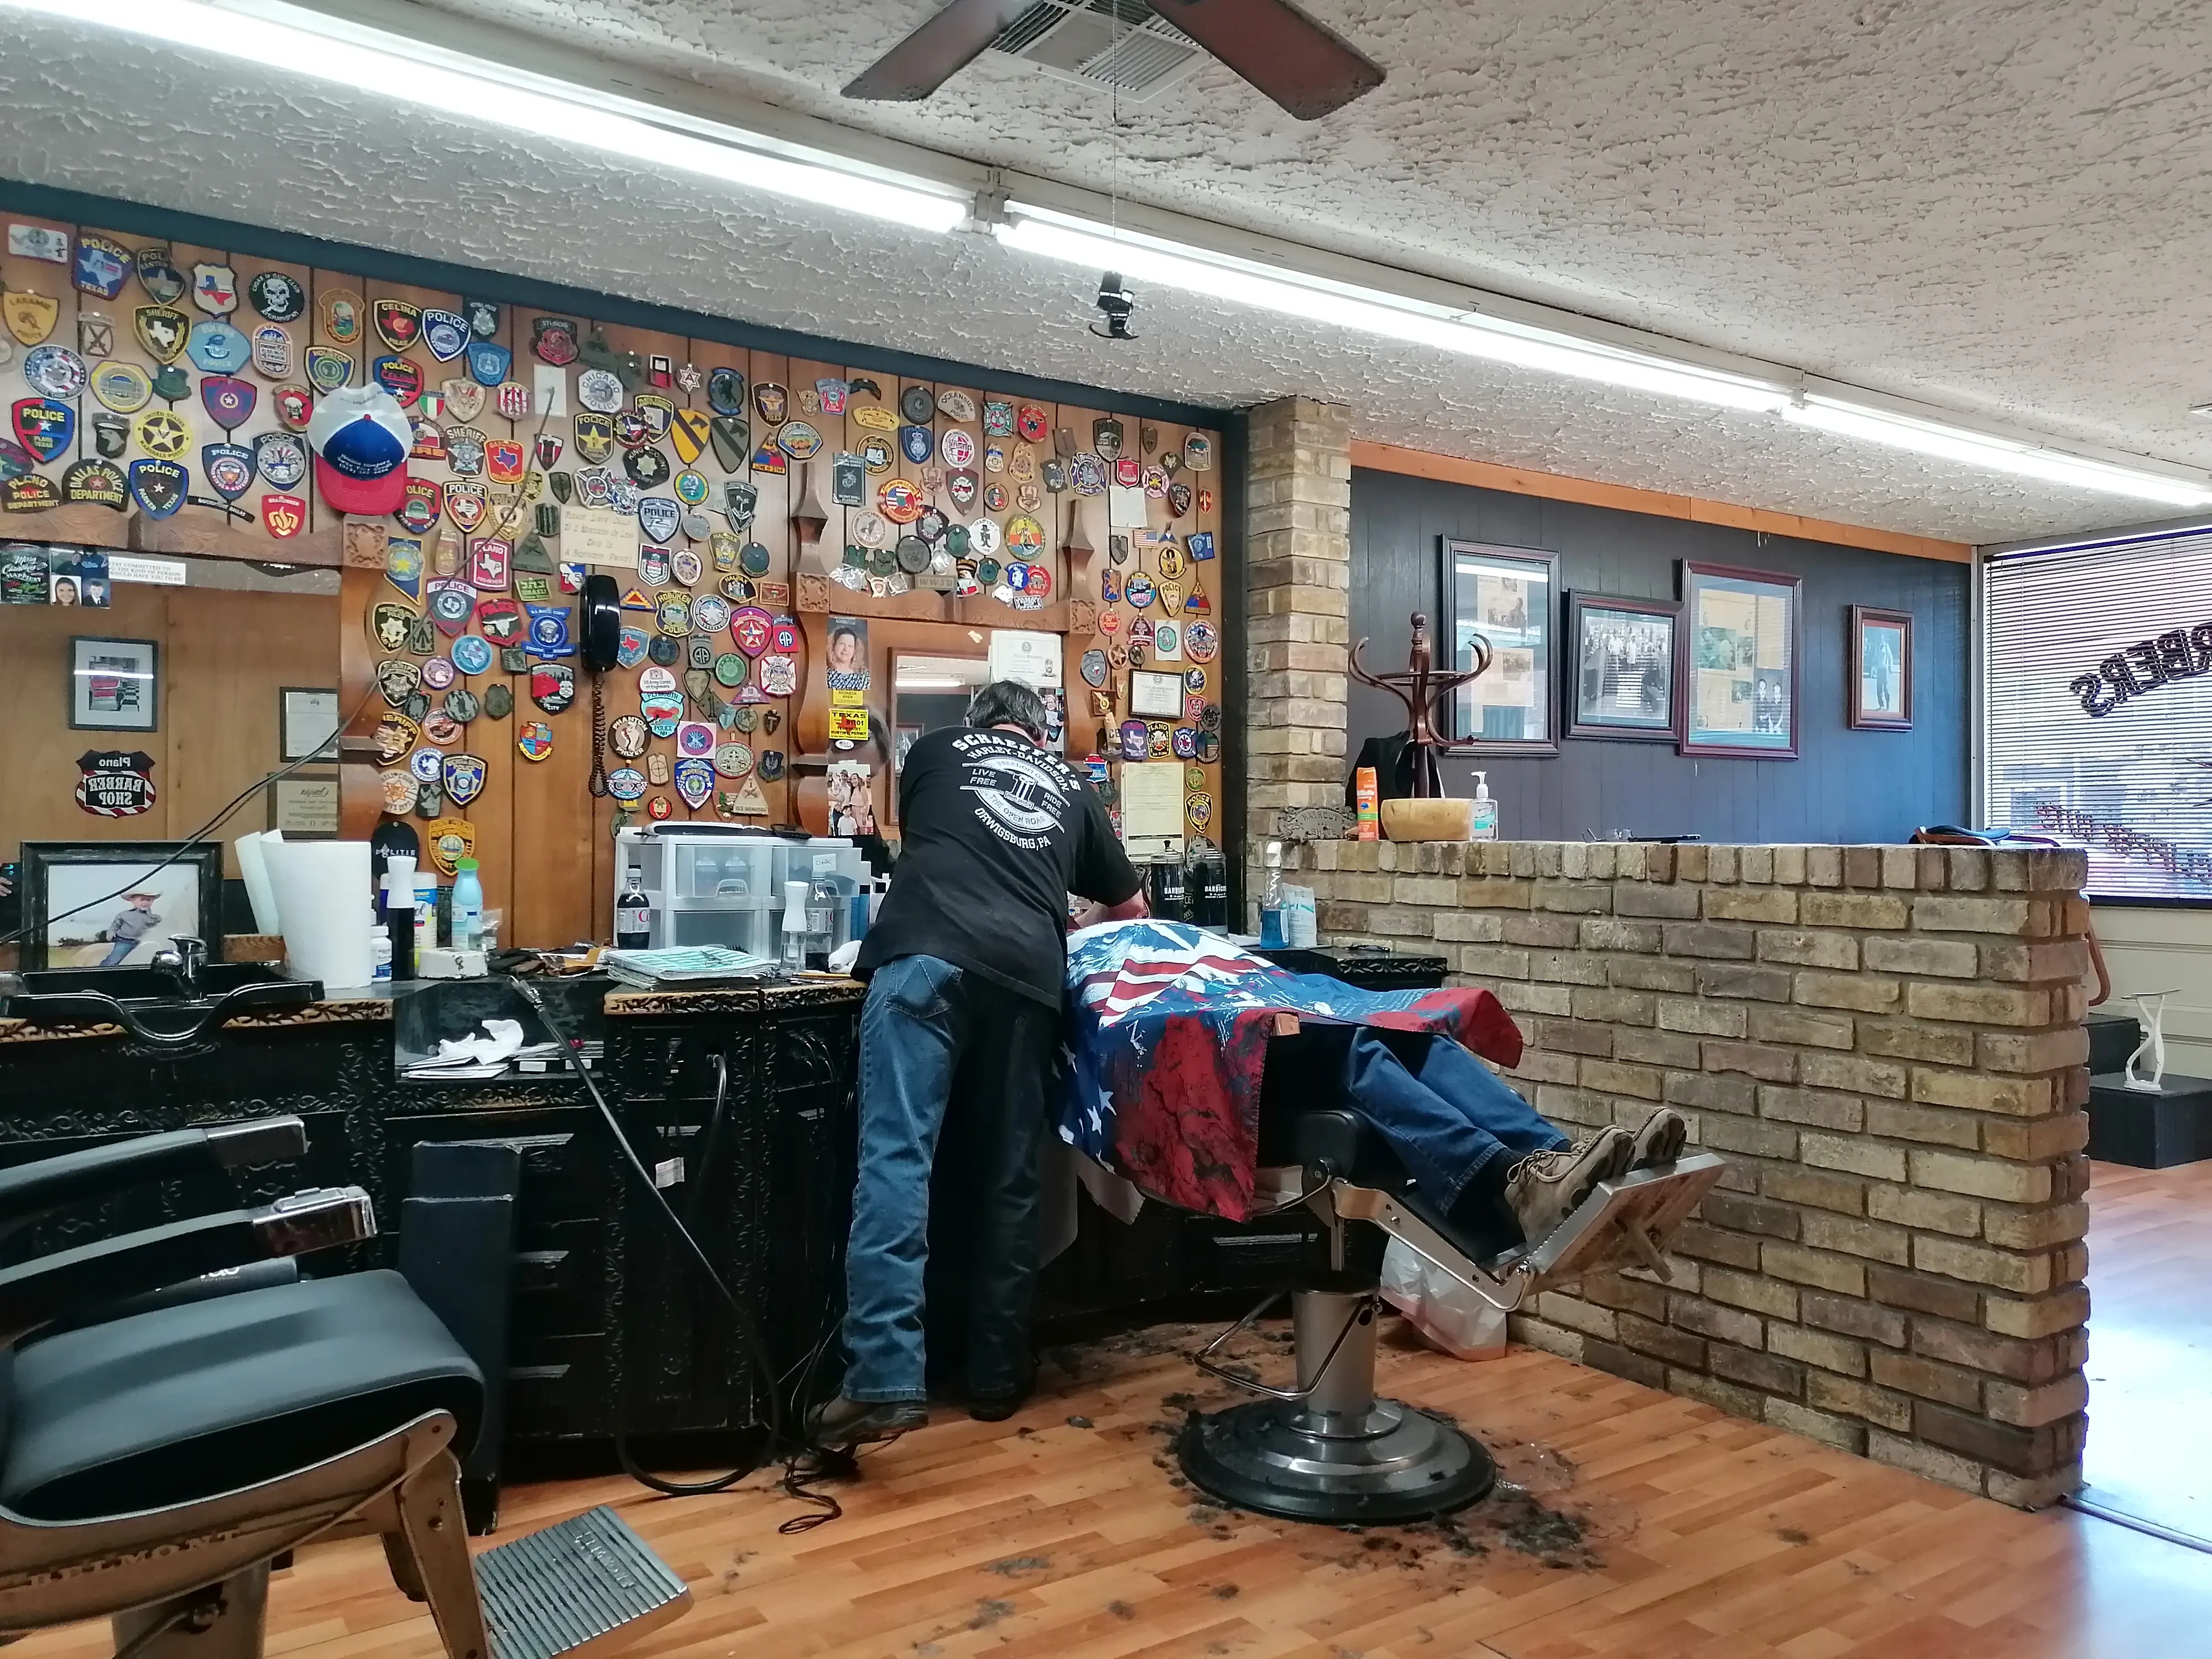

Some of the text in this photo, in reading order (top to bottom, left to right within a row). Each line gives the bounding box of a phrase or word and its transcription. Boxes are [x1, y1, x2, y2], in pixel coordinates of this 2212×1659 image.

[80, 237, 132, 264] POLICE
[145, 309, 179, 320] SHERIFF
[381, 303, 418, 317] CELINA
[427, 312, 468, 332] POLICE
[383, 362, 415, 374] POLICE
[582, 371, 620, 394] CHICAGO
[585, 394, 619, 411] POLICE
[941, 393, 974, 412] OCEANSIDE
[23, 408, 65, 422] POLICE
[578, 416, 612, 426] POLICE
[260, 434, 296, 445] POLICE
[446, 428, 487, 442] SHERIFF
[211, 449, 249, 460] POLICE
[138, 465, 180, 478] POLICE
[70, 465, 124, 494] DALLAS POLICE
[13, 490, 51, 500] POLICE
[406, 485, 434, 498] OLICE
[448, 483, 483, 494] POLICE
[70, 489, 123, 504] DEPARTMENT
[138, 487, 156, 512] PARKER
[161, 493, 179, 511] TEXAS
[644, 508, 675, 518] POLICE
[478, 544, 504, 555] PLANO
[724, 575, 747, 585] HALIFAX
[435, 582, 469, 593] POLICE
[1162, 583, 1181, 594] POLICE
[658, 592, 691, 604] HOBOKEN
[664, 624, 688, 634] POLICE
[382, 713, 418, 735] ERIFF
[612, 716, 648, 732] PHANTOM
[1147, 724, 1168, 732] PLANO
[615, 747, 644, 757] PHLYER
[952, 733, 1082, 792] SCHAEFFER'S
[972, 768, 997, 778] LIVE
[997, 760, 1046, 782] FREEDOM ON
[969, 776, 997, 786] FREE
[1043, 791, 1063, 809] RIDE
[1187, 794, 1210, 807] POLICE
[989, 794, 1001, 808] THE
[1003, 807, 1024, 823] OPEN
[1025, 816, 1046, 825] ROAD
[1041, 801, 1062, 819] FREE
[375, 847, 416, 857] PLITIE
[1164, 886, 1185, 895] BARBICI
